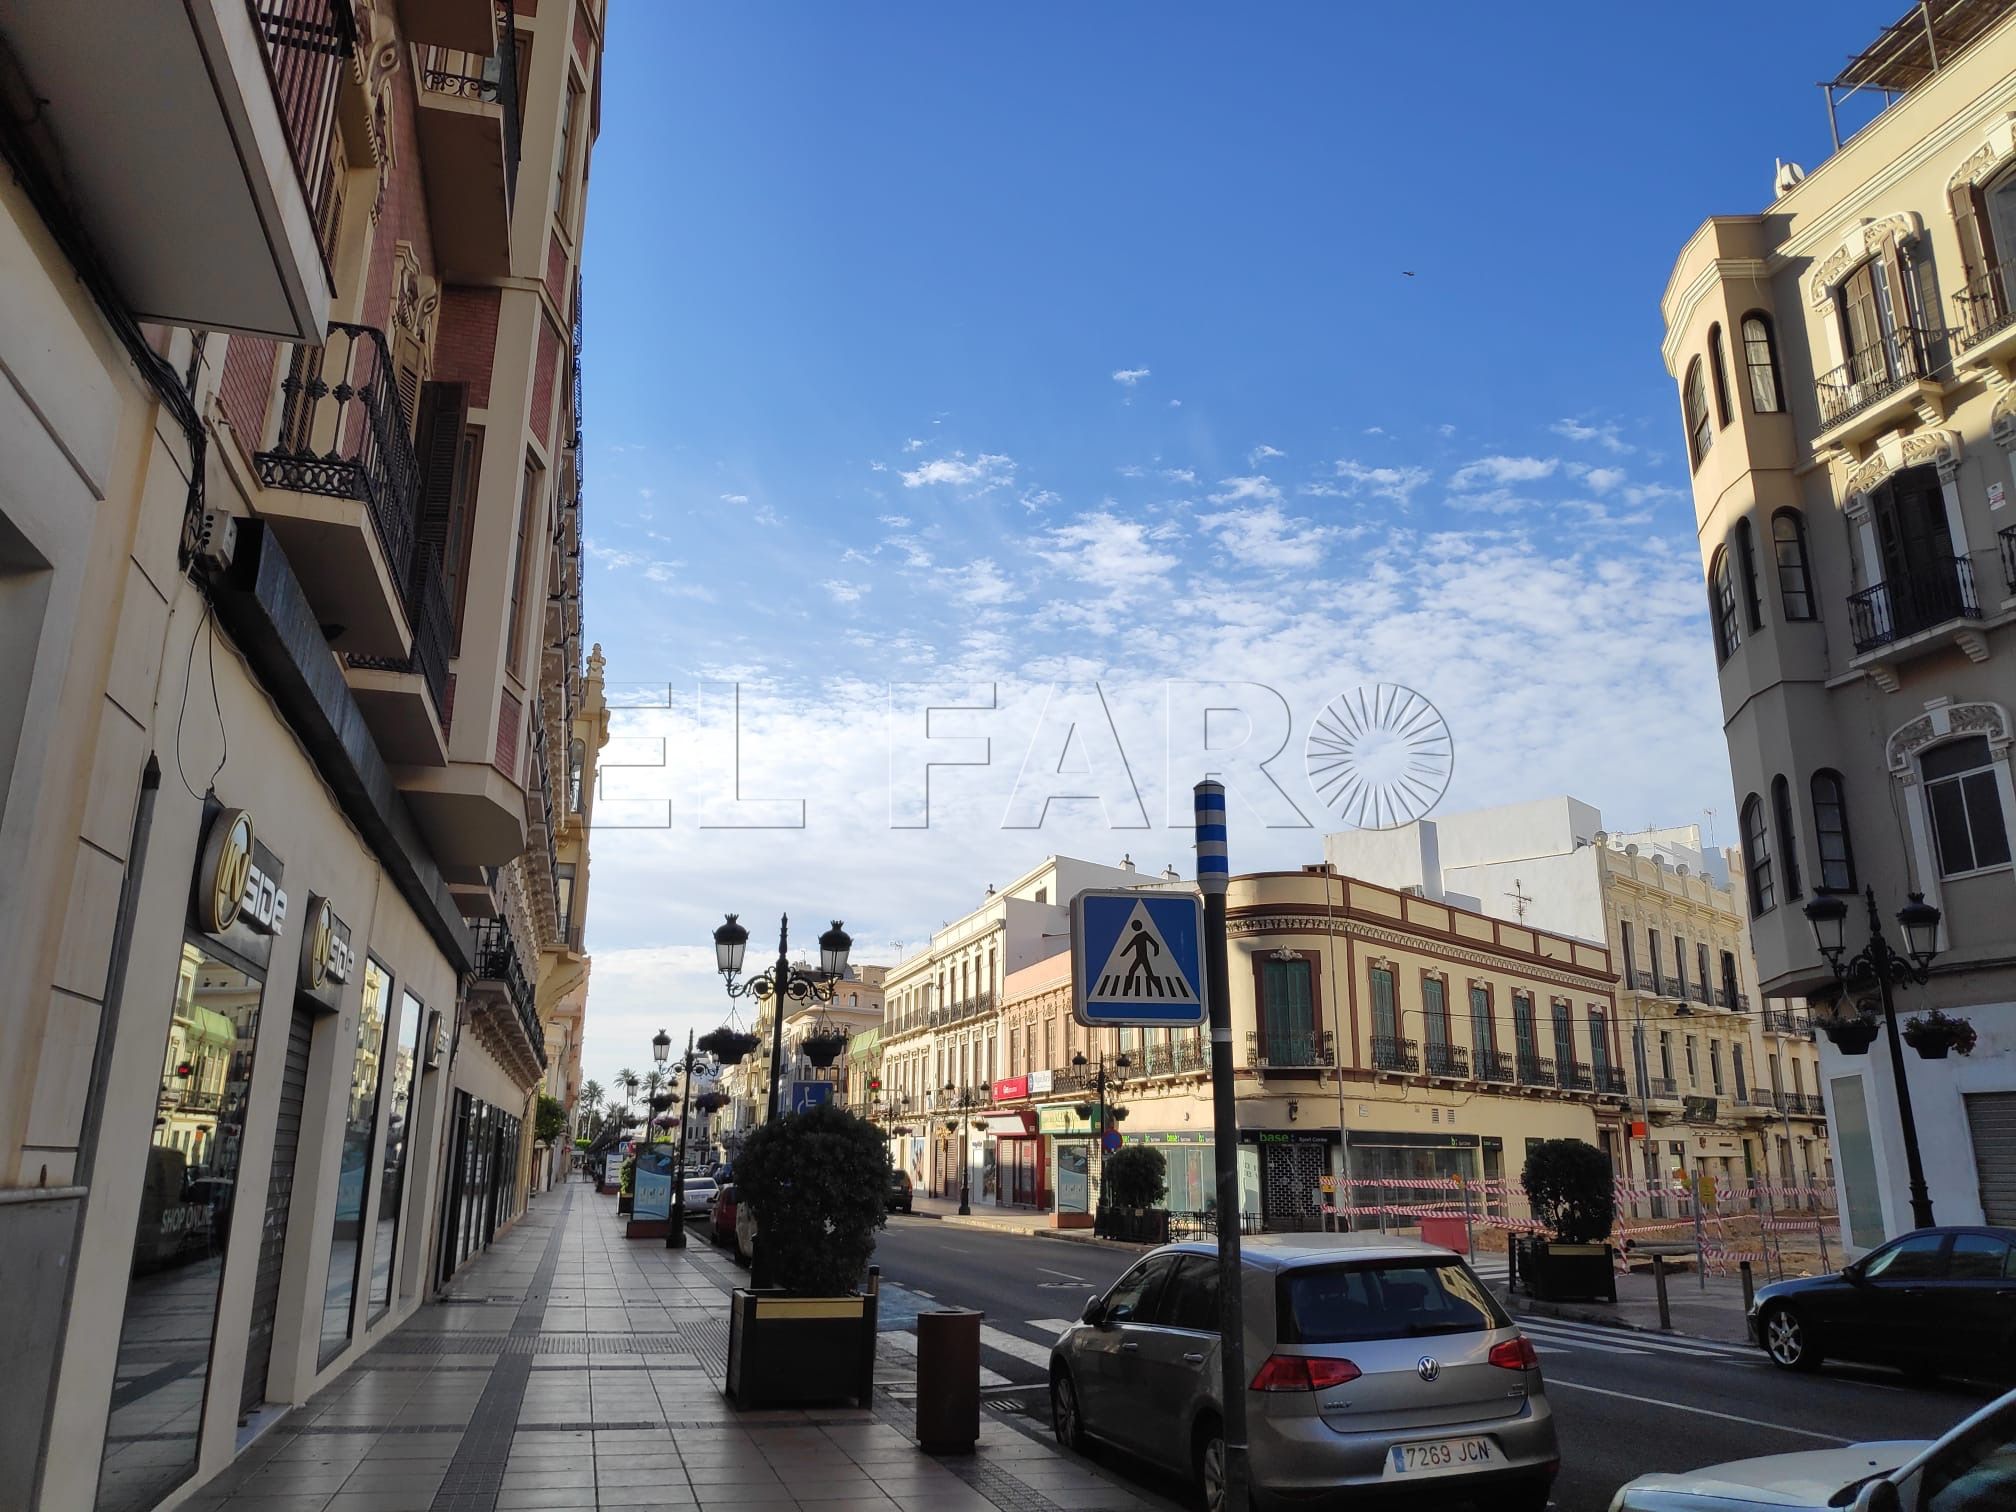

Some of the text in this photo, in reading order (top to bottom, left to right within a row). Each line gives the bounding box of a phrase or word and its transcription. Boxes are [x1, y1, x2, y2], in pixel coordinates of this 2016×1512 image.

[161, 1207, 185, 1233] SHOP
[1406, 1440, 1489, 1468] 7269 JCN
